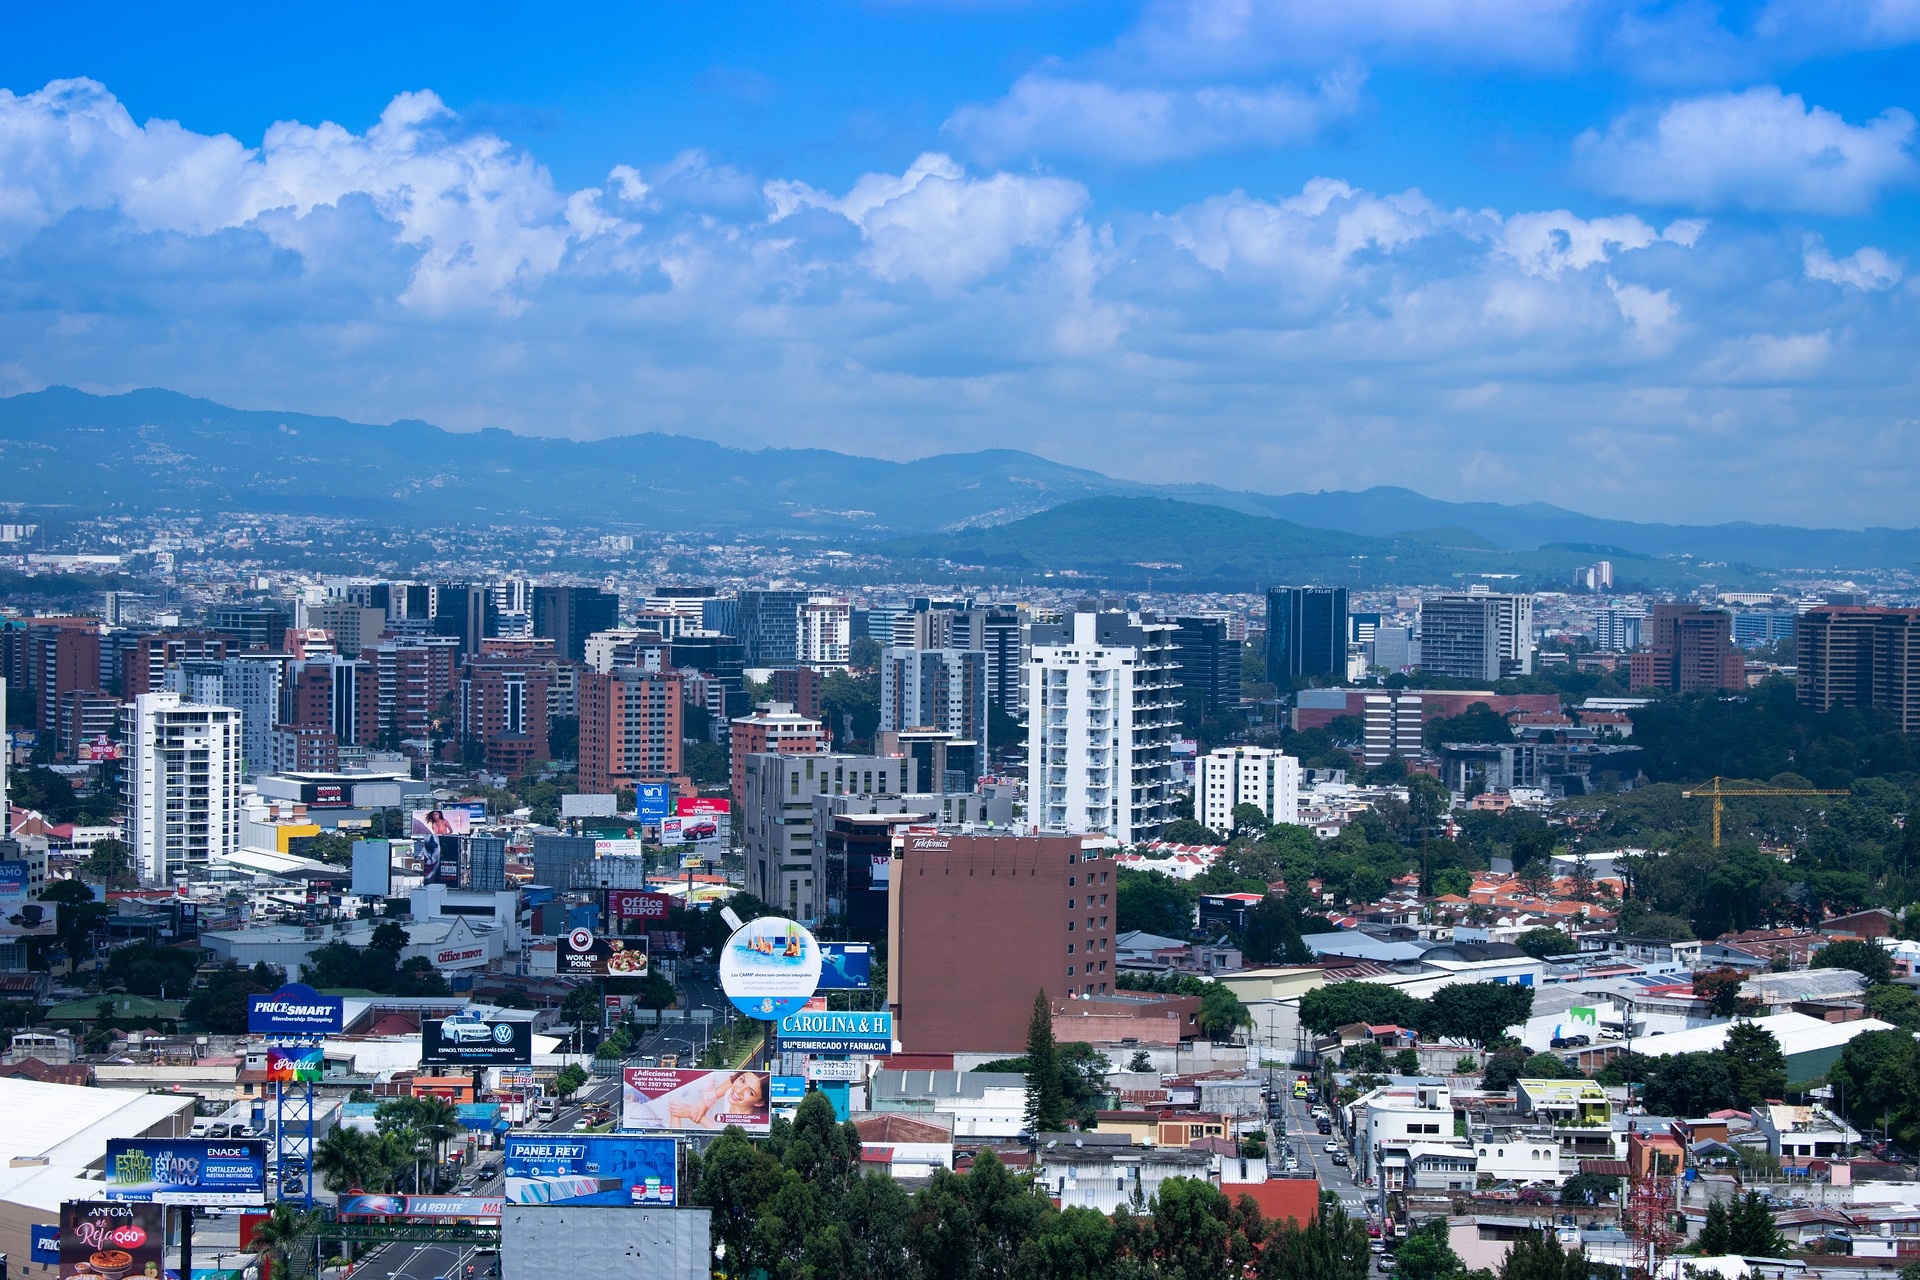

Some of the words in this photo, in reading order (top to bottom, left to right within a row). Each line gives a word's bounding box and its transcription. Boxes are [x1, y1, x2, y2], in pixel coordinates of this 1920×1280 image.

[873, 856, 889, 865] AP
[621, 896, 664, 908] Office
[623, 908, 663, 916] DEPOT
[438, 951, 461, 964] Office
[462, 949, 483, 960] DEPOT
[782, 1016, 856, 1032] CAROLINA
[858, 1018, 870, 1033] &
[873, 1018, 888, 1033] H.
[782, 1041, 842, 1050] SUPERMERCADO
[842, 1042, 848, 1050] Y
[850, 1042, 887, 1051] FARMACIA
[274, 1058, 316, 1070] Paleta
[164, 1150, 173, 1158] UN
[207, 1148, 241, 1156] ENADE
[516, 1146, 552, 1156] PANEL
[556, 1146, 580, 1156] REY
[116, 1155, 152, 1170] ESTADO
[155, 1157, 199, 1172] ESTADO
[88, 1208, 134, 1217] ANFORA
[414, 1203, 428, 1212] LA
[428, 1204, 446, 1212] RED
[447, 1204, 463, 1213] LTE
[114, 1232, 138, 1244] Q60
